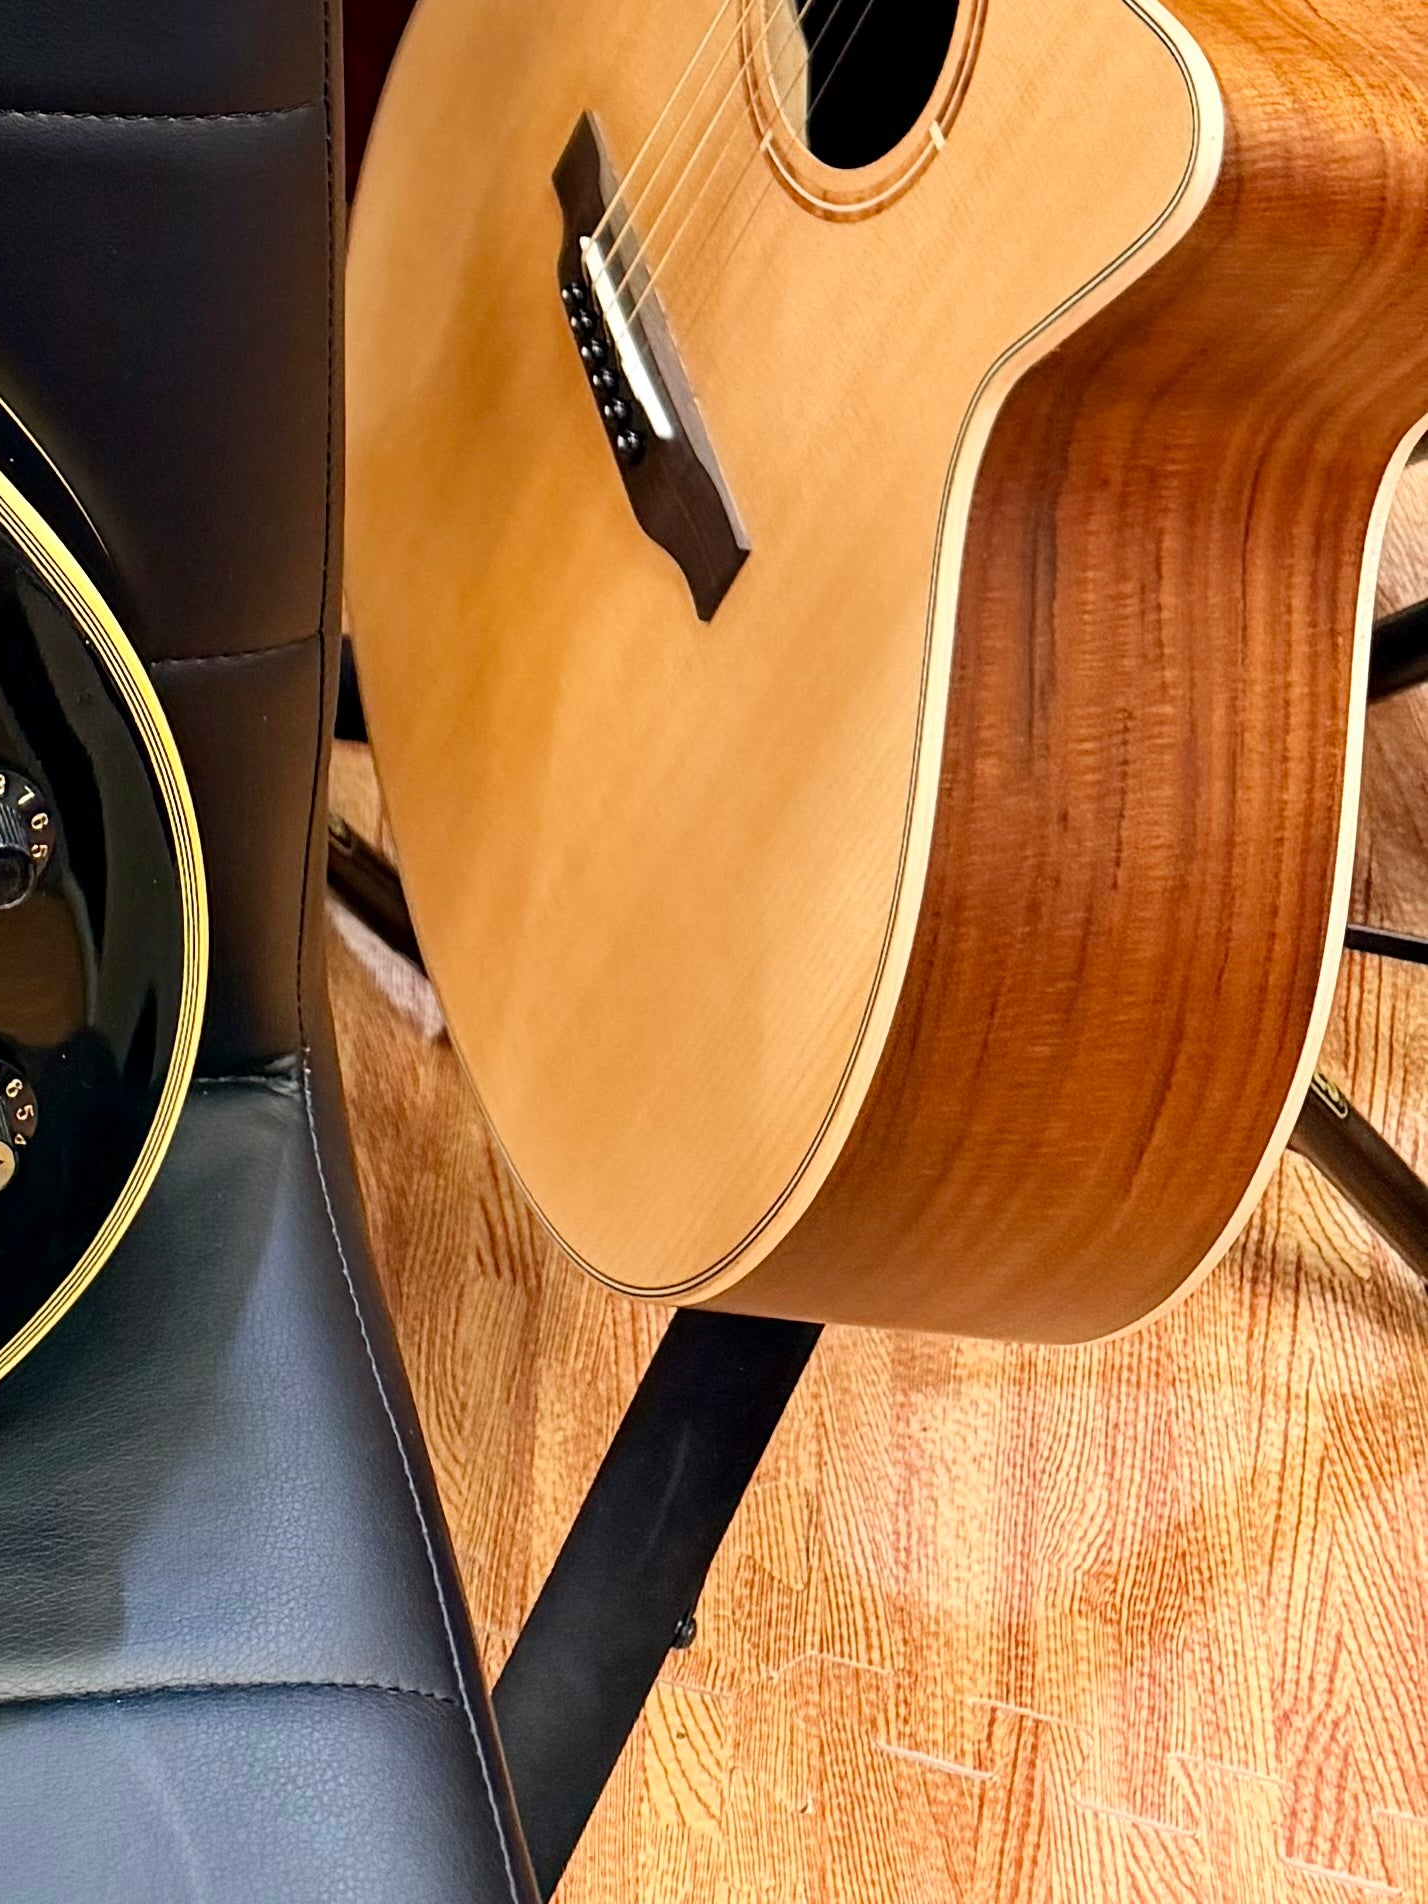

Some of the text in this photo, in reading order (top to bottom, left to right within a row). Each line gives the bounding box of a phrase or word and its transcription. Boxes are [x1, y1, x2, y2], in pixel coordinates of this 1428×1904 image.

[18, 785, 35, 805] 7
[31, 812, 49, 830] 6
[31, 844, 48, 858] 5
[5, 1079, 23, 1097] 6
[16, 1104, 34, 1120] 5
